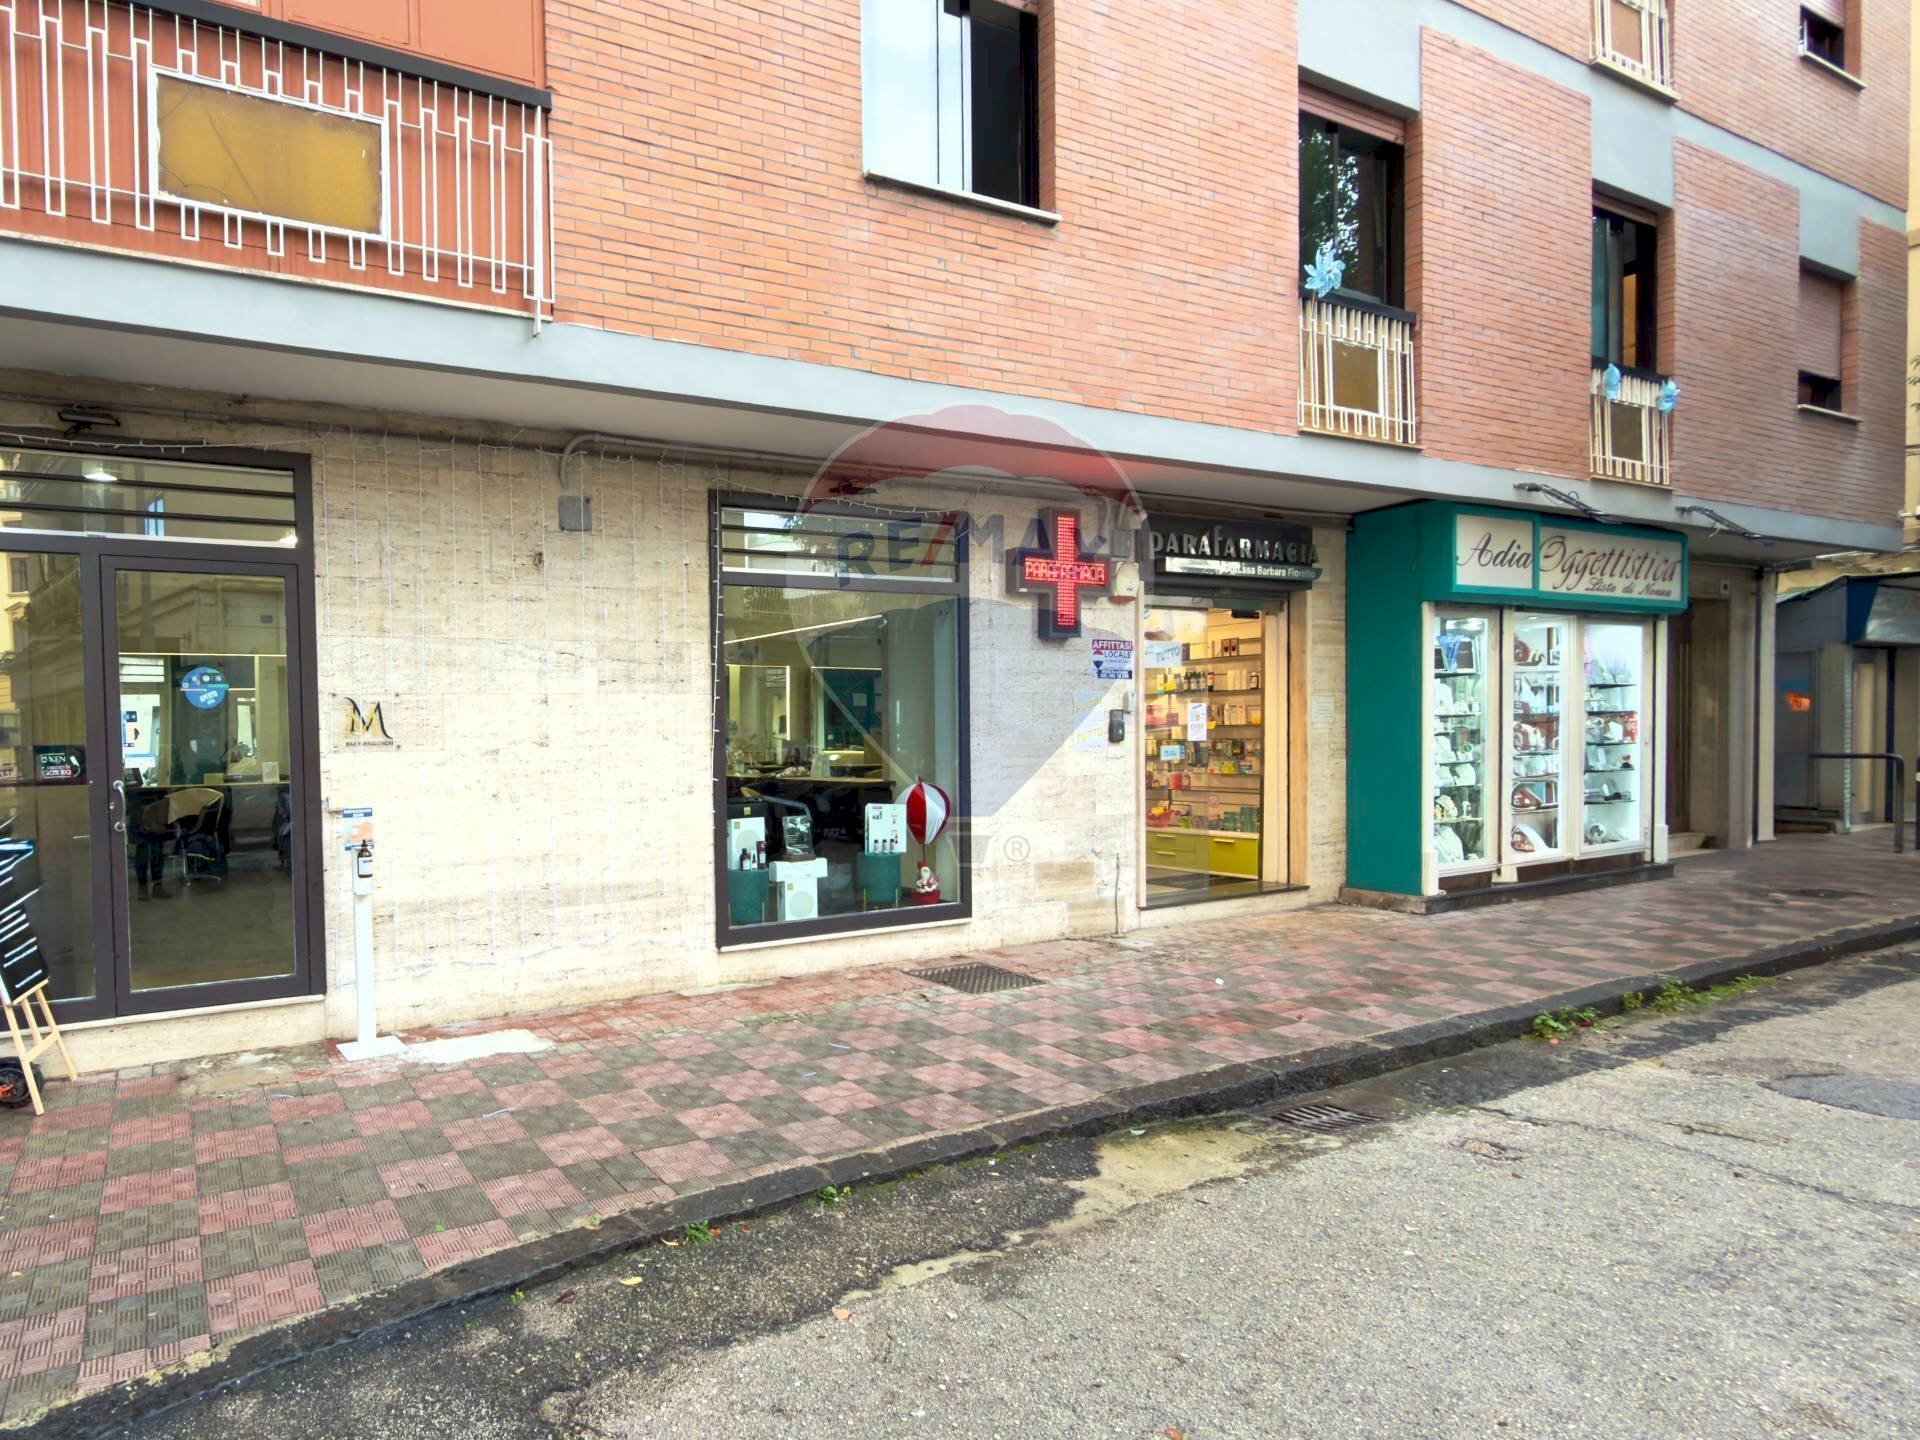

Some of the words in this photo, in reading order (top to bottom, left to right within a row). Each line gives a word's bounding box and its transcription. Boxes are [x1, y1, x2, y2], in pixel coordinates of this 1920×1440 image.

[1456, 531, 1534, 568] Adia
[1538, 535, 1682, 590] Oggettistica
[1257, 564, 1286, 577] Barbara
[1622, 582, 1634, 594] di
[1093, 640, 1132, 650] AFFITTASI
[1104, 651, 1132, 659] LOCALE
